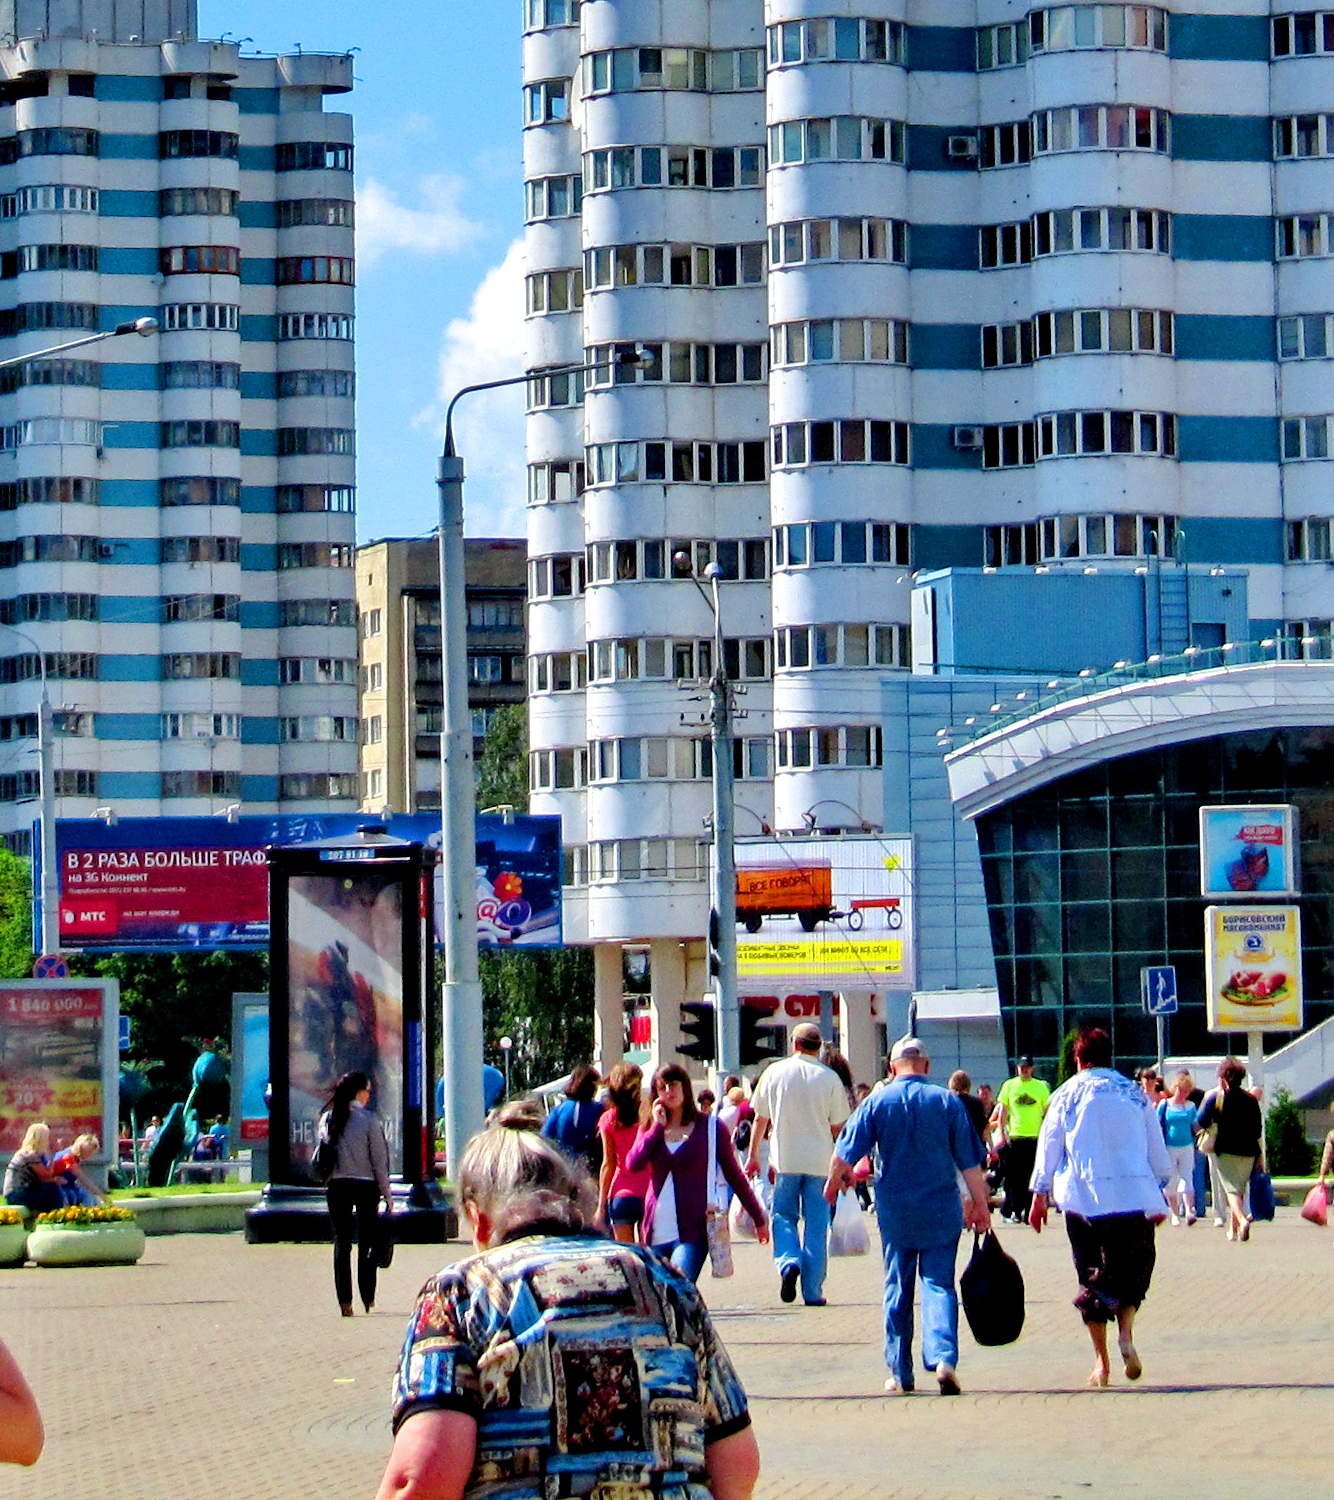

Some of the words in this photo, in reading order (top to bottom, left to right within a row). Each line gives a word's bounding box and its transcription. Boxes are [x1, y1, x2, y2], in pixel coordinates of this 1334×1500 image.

[68, 852, 79, 869] В
[83, 853, 94, 868] 2
[98, 852, 139, 868] РАЗА
[144, 850, 219, 868] БОЛЬШЕ
[68, 874, 82, 883] на
[85, 872, 99, 882] 3G
[101, 872, 148, 883] Коннект
[749, 880, 768, 893] ВСЕ
[769, 873, 812, 890] ГОВОРЯТ
[80, 911, 106, 921] МТС
[1222, 914, 1286, 924] БОРИСОВСКИЙ
[1223, 923, 1286, 932] МЯСОКОМБИНАТ
